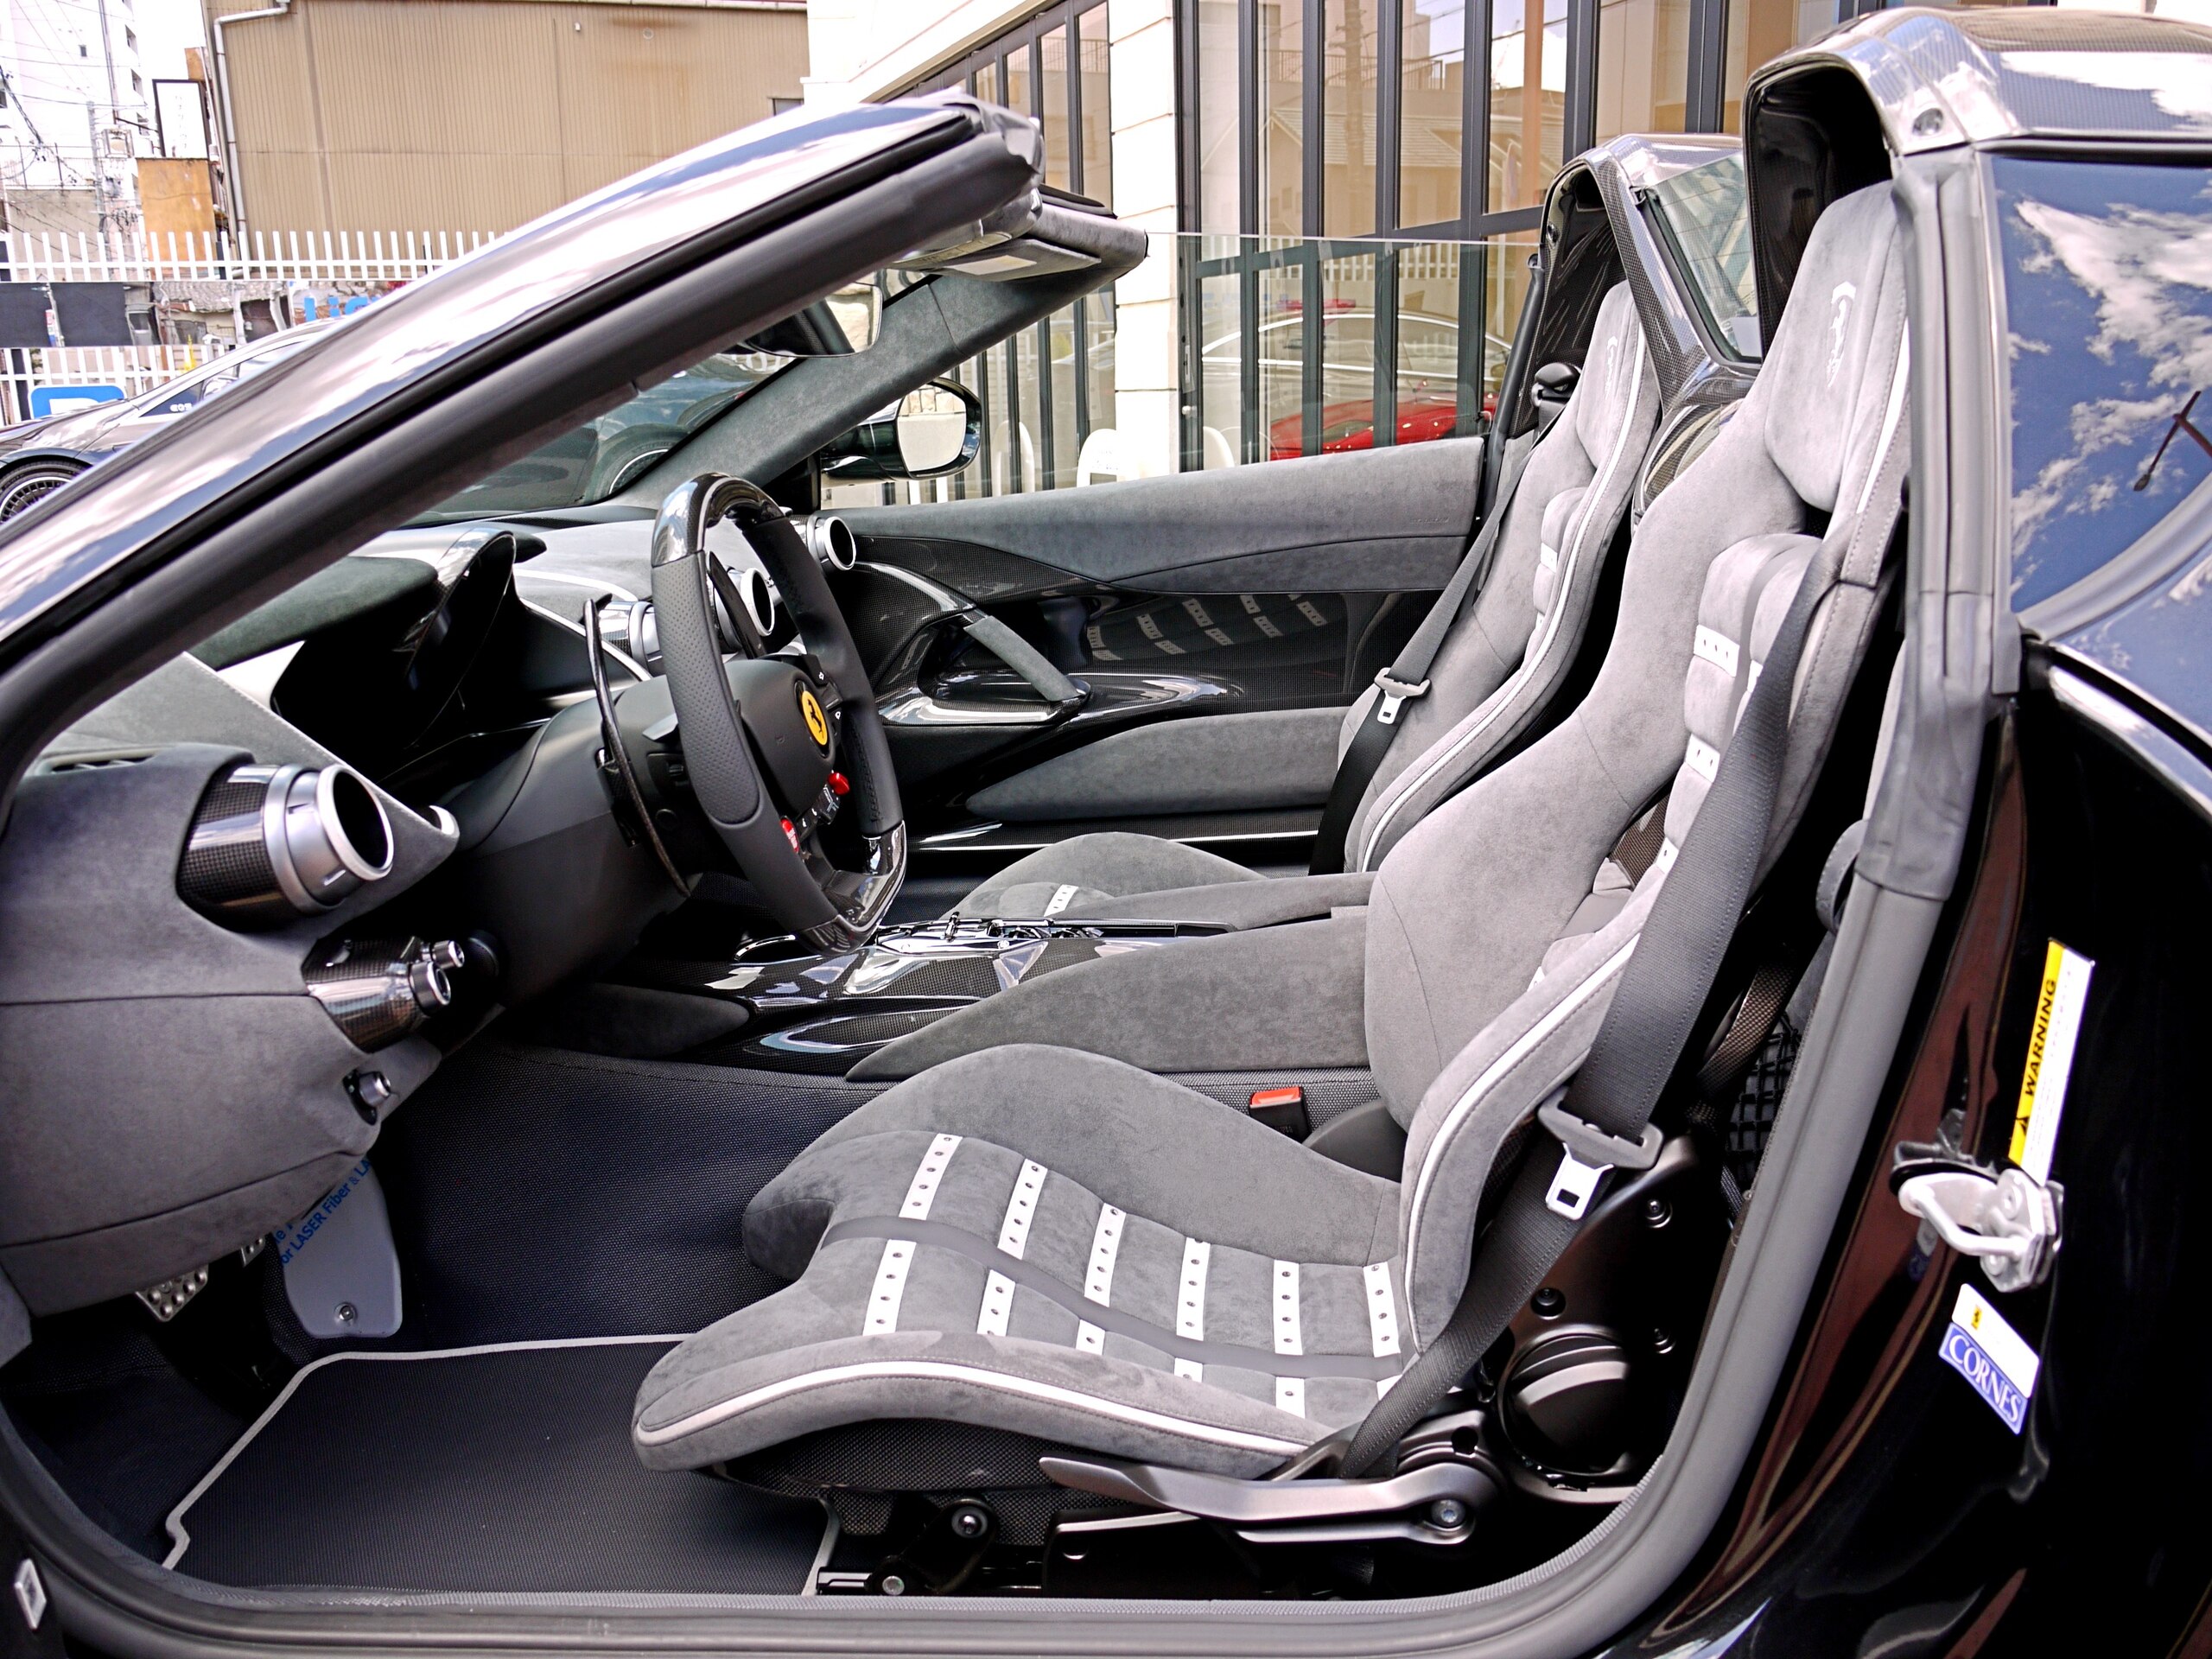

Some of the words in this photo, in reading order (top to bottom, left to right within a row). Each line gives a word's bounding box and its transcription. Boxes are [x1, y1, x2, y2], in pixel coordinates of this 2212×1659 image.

[2024, 979, 2056, 1096] WARNING
[289, 1211, 327, 1250] LASER
[321, 1183, 352, 1214] Fiber
[349, 1176, 360, 1185] &
[1948, 1334, 2022, 1423] CORNES
